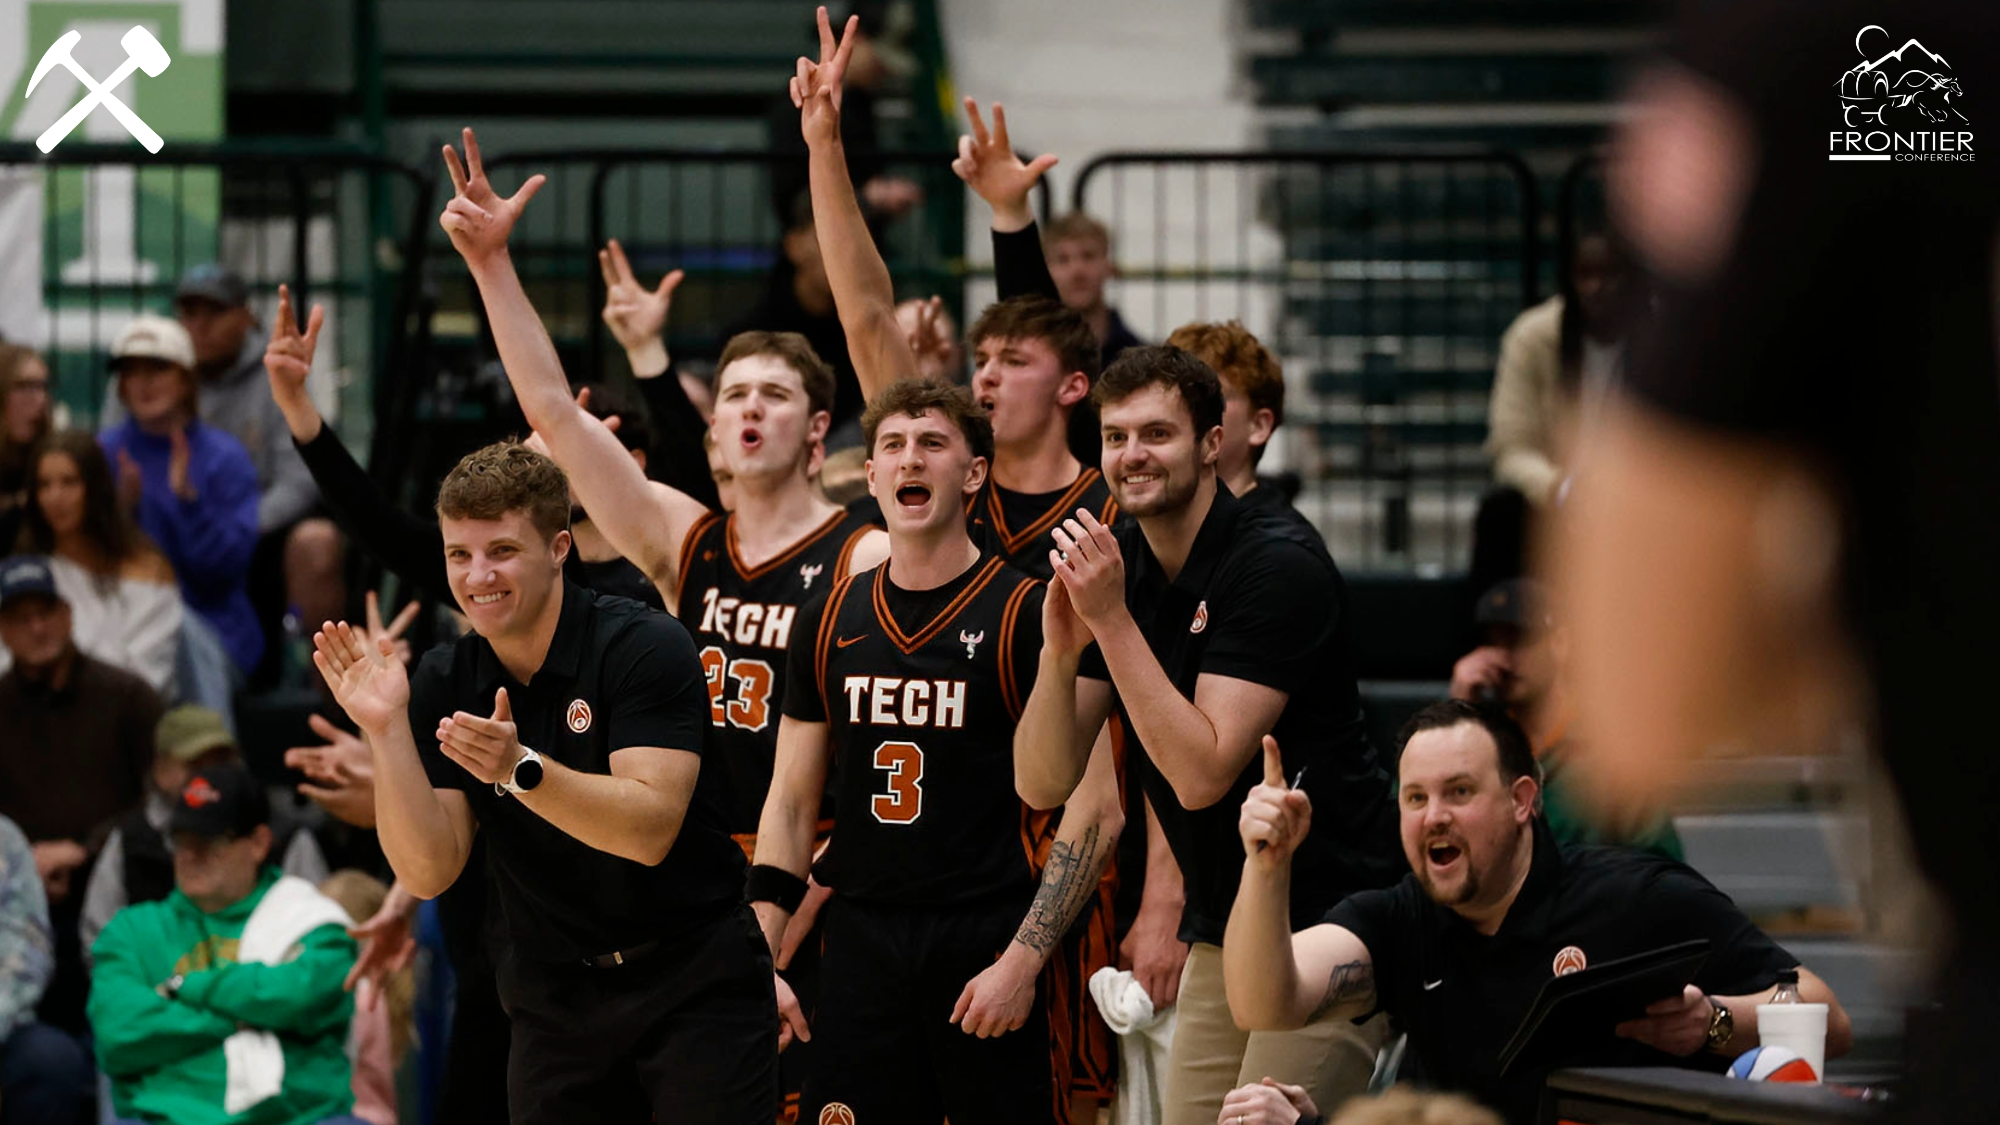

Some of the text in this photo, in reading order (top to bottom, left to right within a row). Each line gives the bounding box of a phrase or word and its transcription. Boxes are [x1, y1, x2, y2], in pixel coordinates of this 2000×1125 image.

[699, 645, 775, 733] 23
[843, 675, 967, 728] TECH
[871, 740, 924, 824] 3
